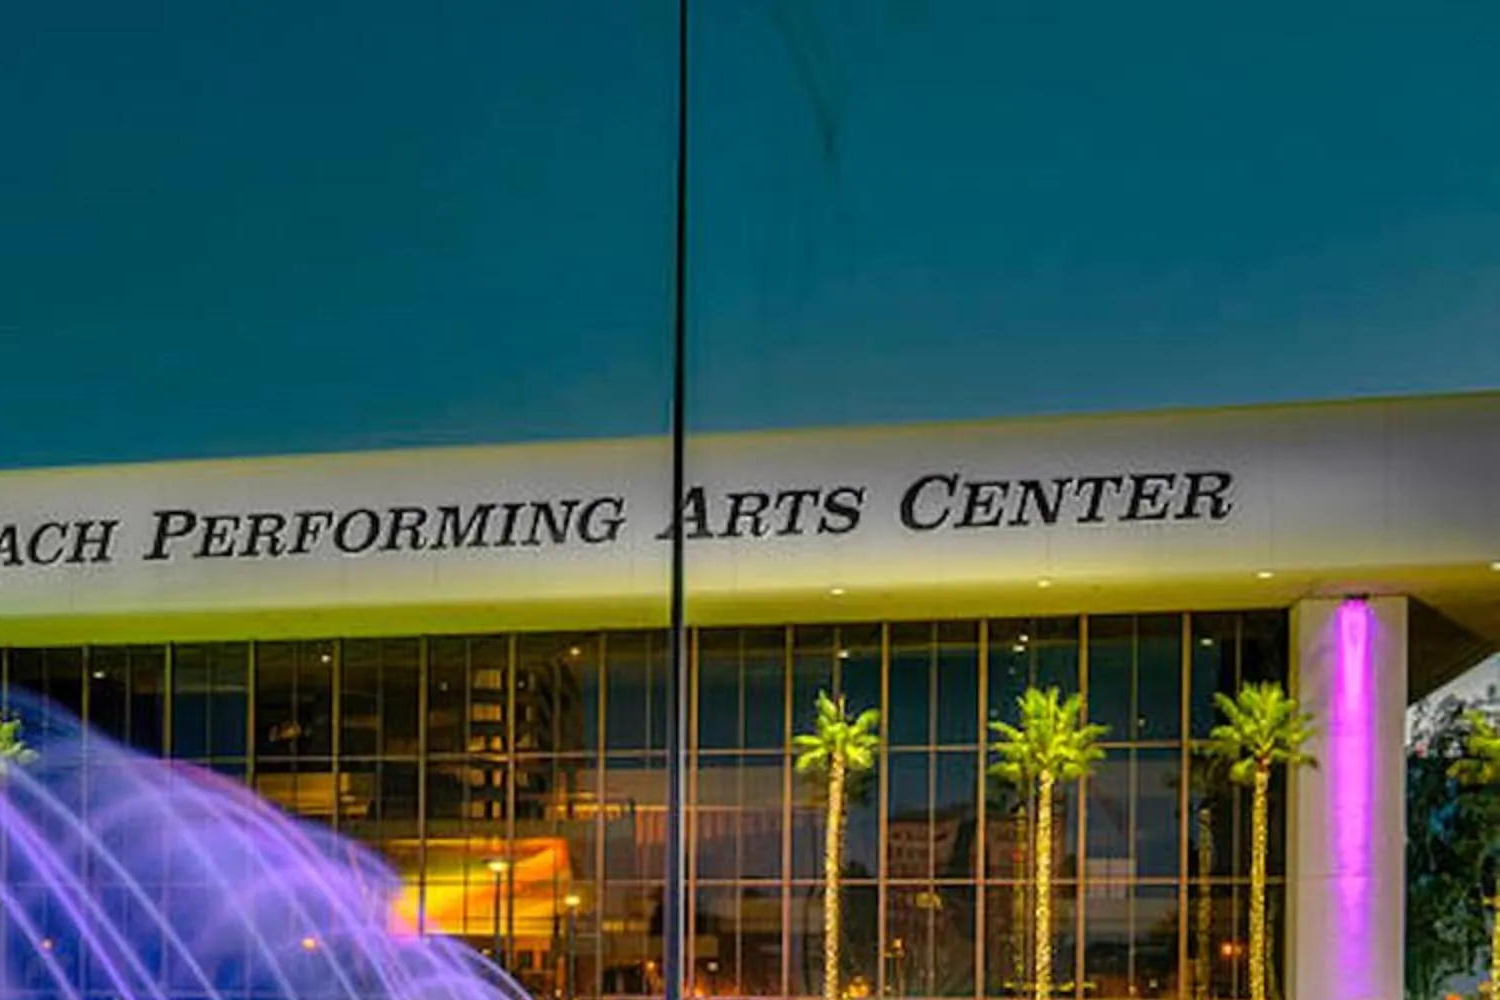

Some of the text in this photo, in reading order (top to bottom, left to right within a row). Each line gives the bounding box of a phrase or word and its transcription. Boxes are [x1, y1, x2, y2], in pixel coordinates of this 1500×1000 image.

[142, 497, 626, 561] PERFORMING
[655, 485, 867, 541] ARTS
[900, 470, 1234, 530] CENTER
